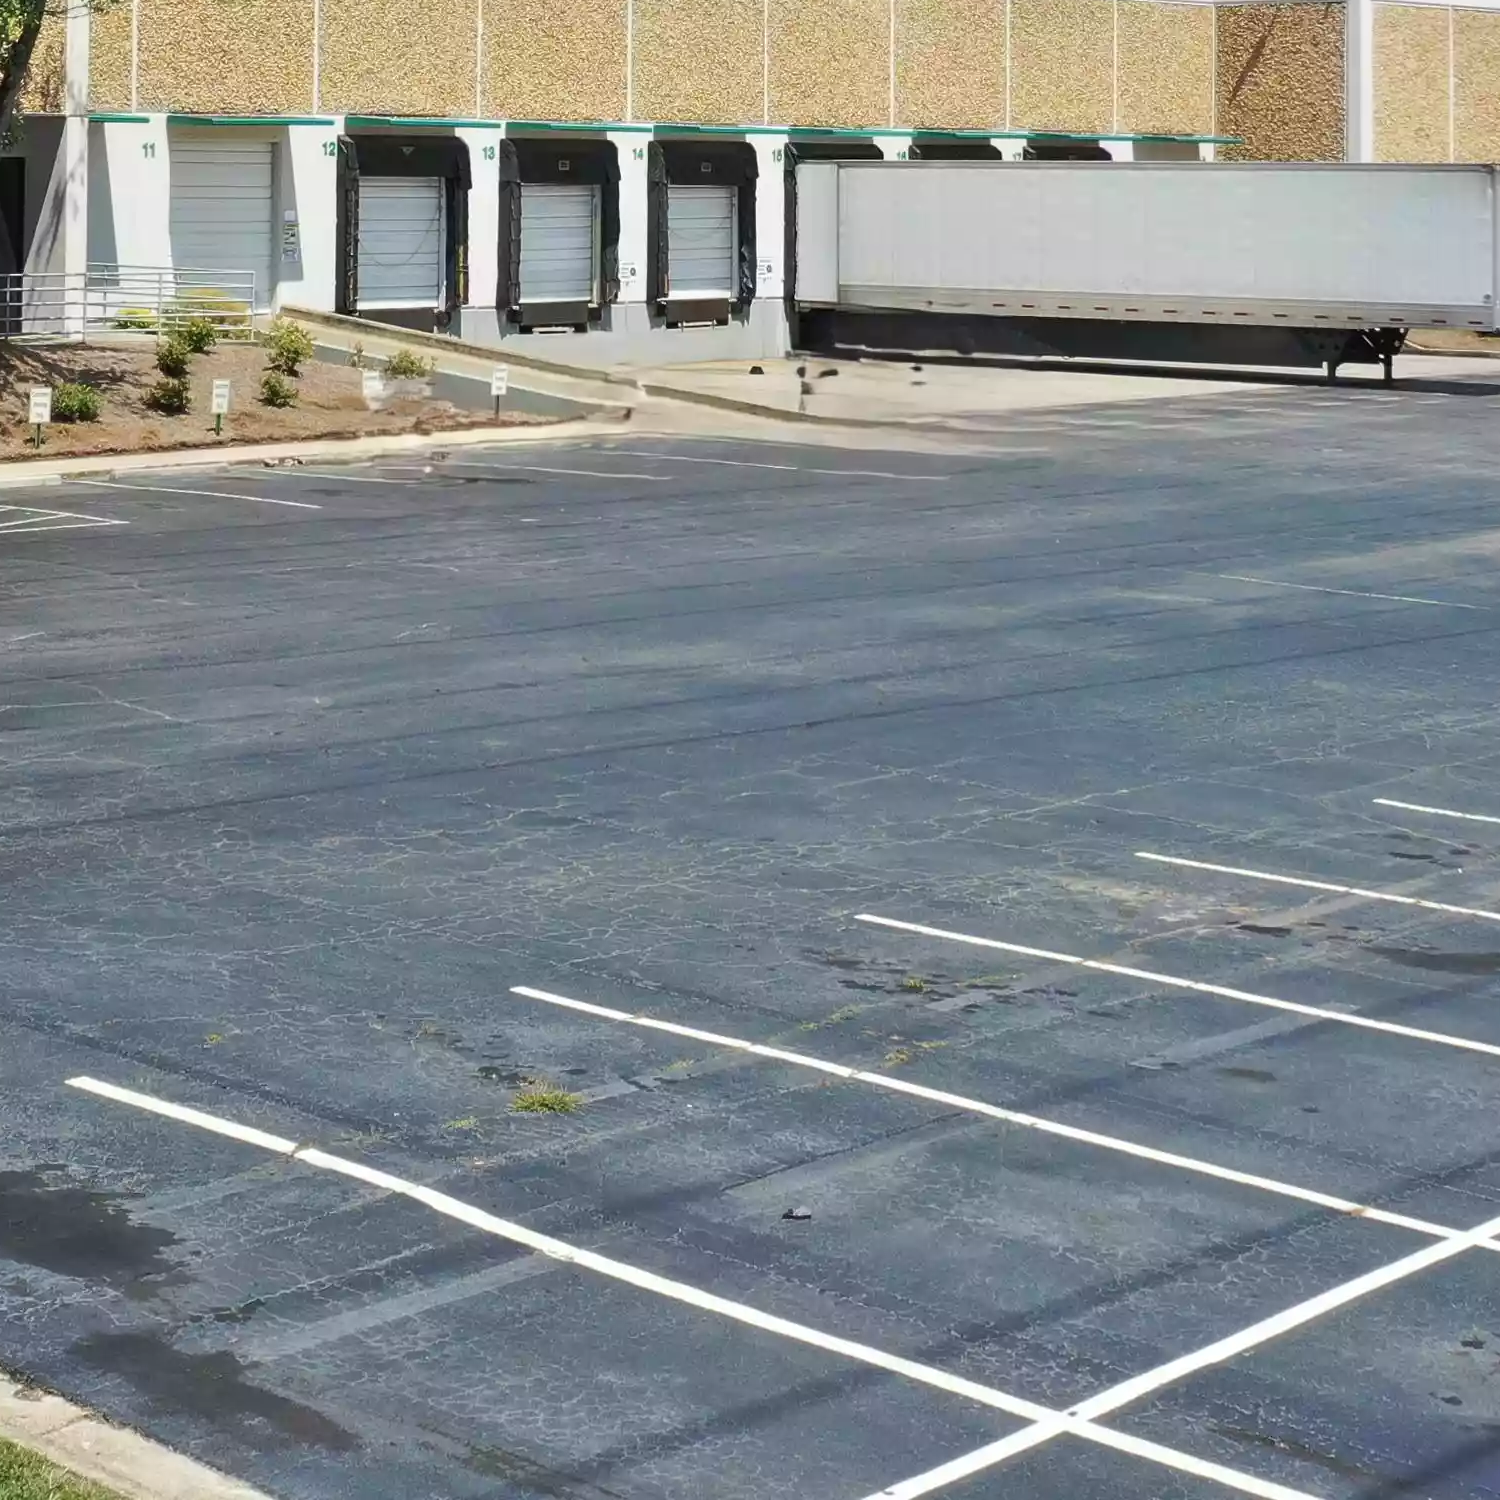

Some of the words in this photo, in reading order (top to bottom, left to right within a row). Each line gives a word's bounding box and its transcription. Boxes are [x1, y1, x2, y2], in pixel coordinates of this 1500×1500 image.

[142, 142, 156, 159] 11
[322, 141, 336, 157] 12
[482, 146, 495, 161] 13
[632, 148, 644, 161] 14
